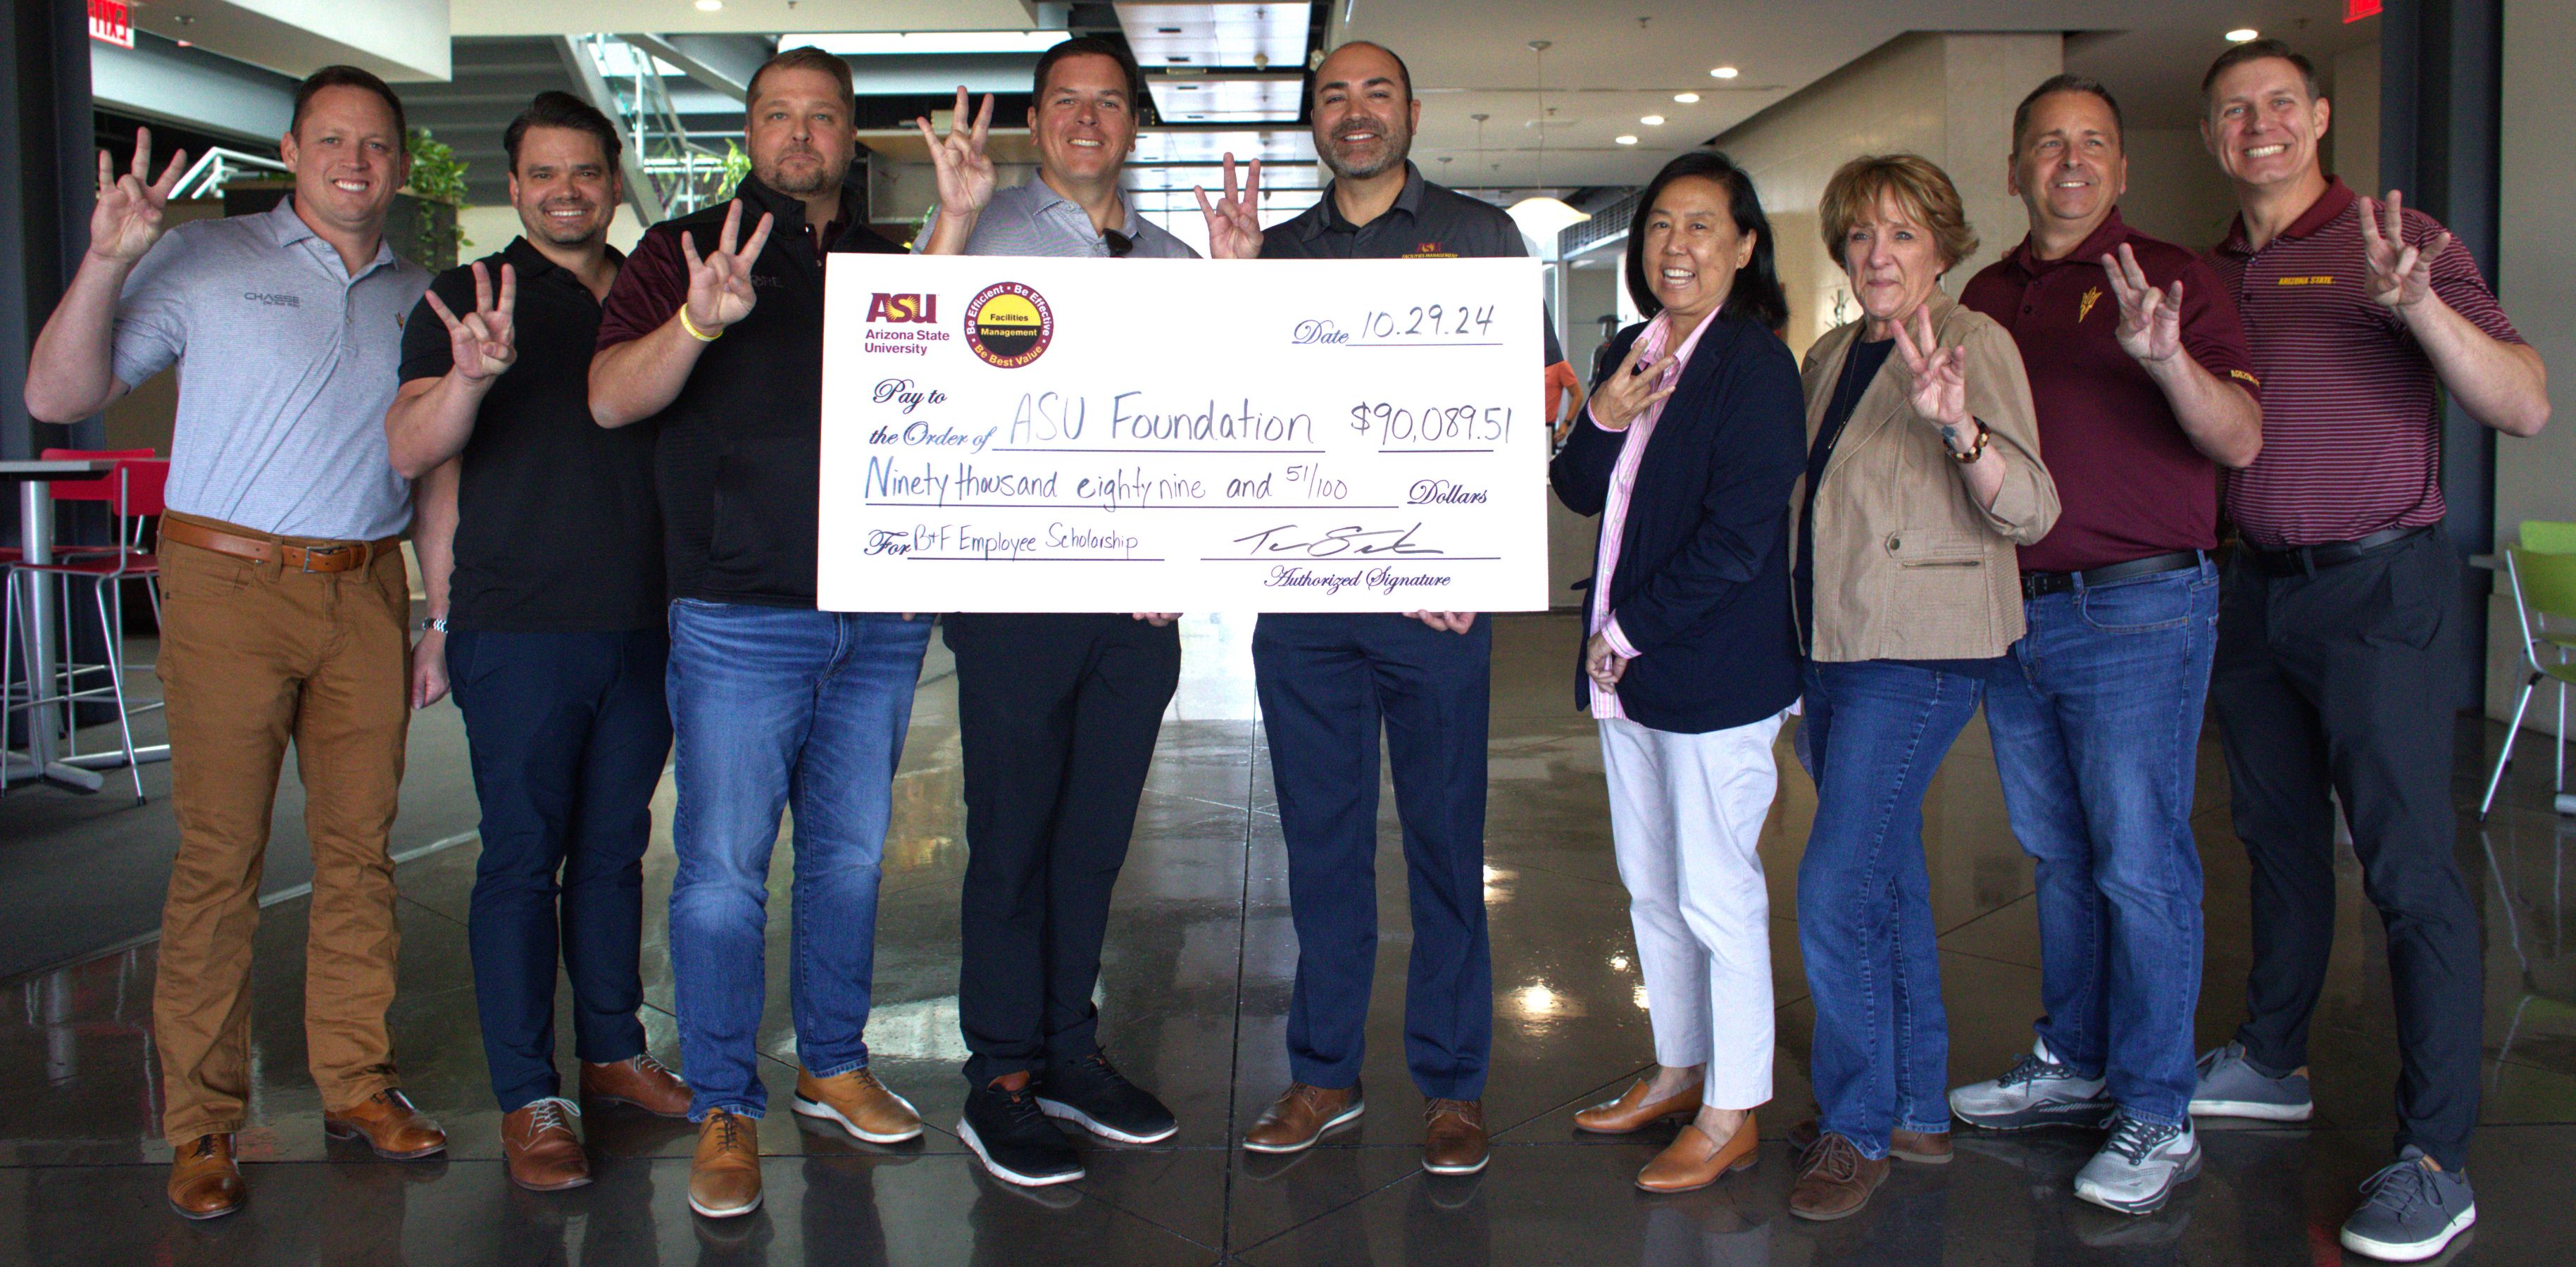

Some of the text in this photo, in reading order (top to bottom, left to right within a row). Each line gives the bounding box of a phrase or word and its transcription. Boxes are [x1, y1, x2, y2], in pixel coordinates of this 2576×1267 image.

[2277, 275, 2332, 285] ARIZONA STATE
[244, 292, 300, 304] CHASSE
[865, 292, 937, 324] ASU
[966, 285, 1004, 335] Be Efficient
[1014, 285, 1052, 337] Be Effective
[865, 329, 950, 341] Arizona State
[981, 328, 1037, 337] Management
[1292, 319, 1349, 344] Date
[1362, 304, 1494, 339] 10.29.24
[865, 342, 927, 356] University
[974, 344, 1042, 366] Be Best Value
[873, 378, 948, 414] Pay to
[1011, 391, 1314, 444] ASU Foundation
[1351, 401, 1512, 444] $90,089.51
[869, 420, 998, 454] the Order of
[865, 456, 949, 508] Ninety
[954, 462, 1058, 501] thousand
[1077, 466, 1153, 512] eighty
[1158, 473, 1206, 499] nine
[1227, 472, 1273, 499] and
[1406, 479, 1487, 505] Dollars
[863, 529, 913, 556] For
[958, 524, 1037, 562] Employee
[1045, 522, 1139, 561] Scholarship
[1264, 564, 1451, 595] Authorized Signature
